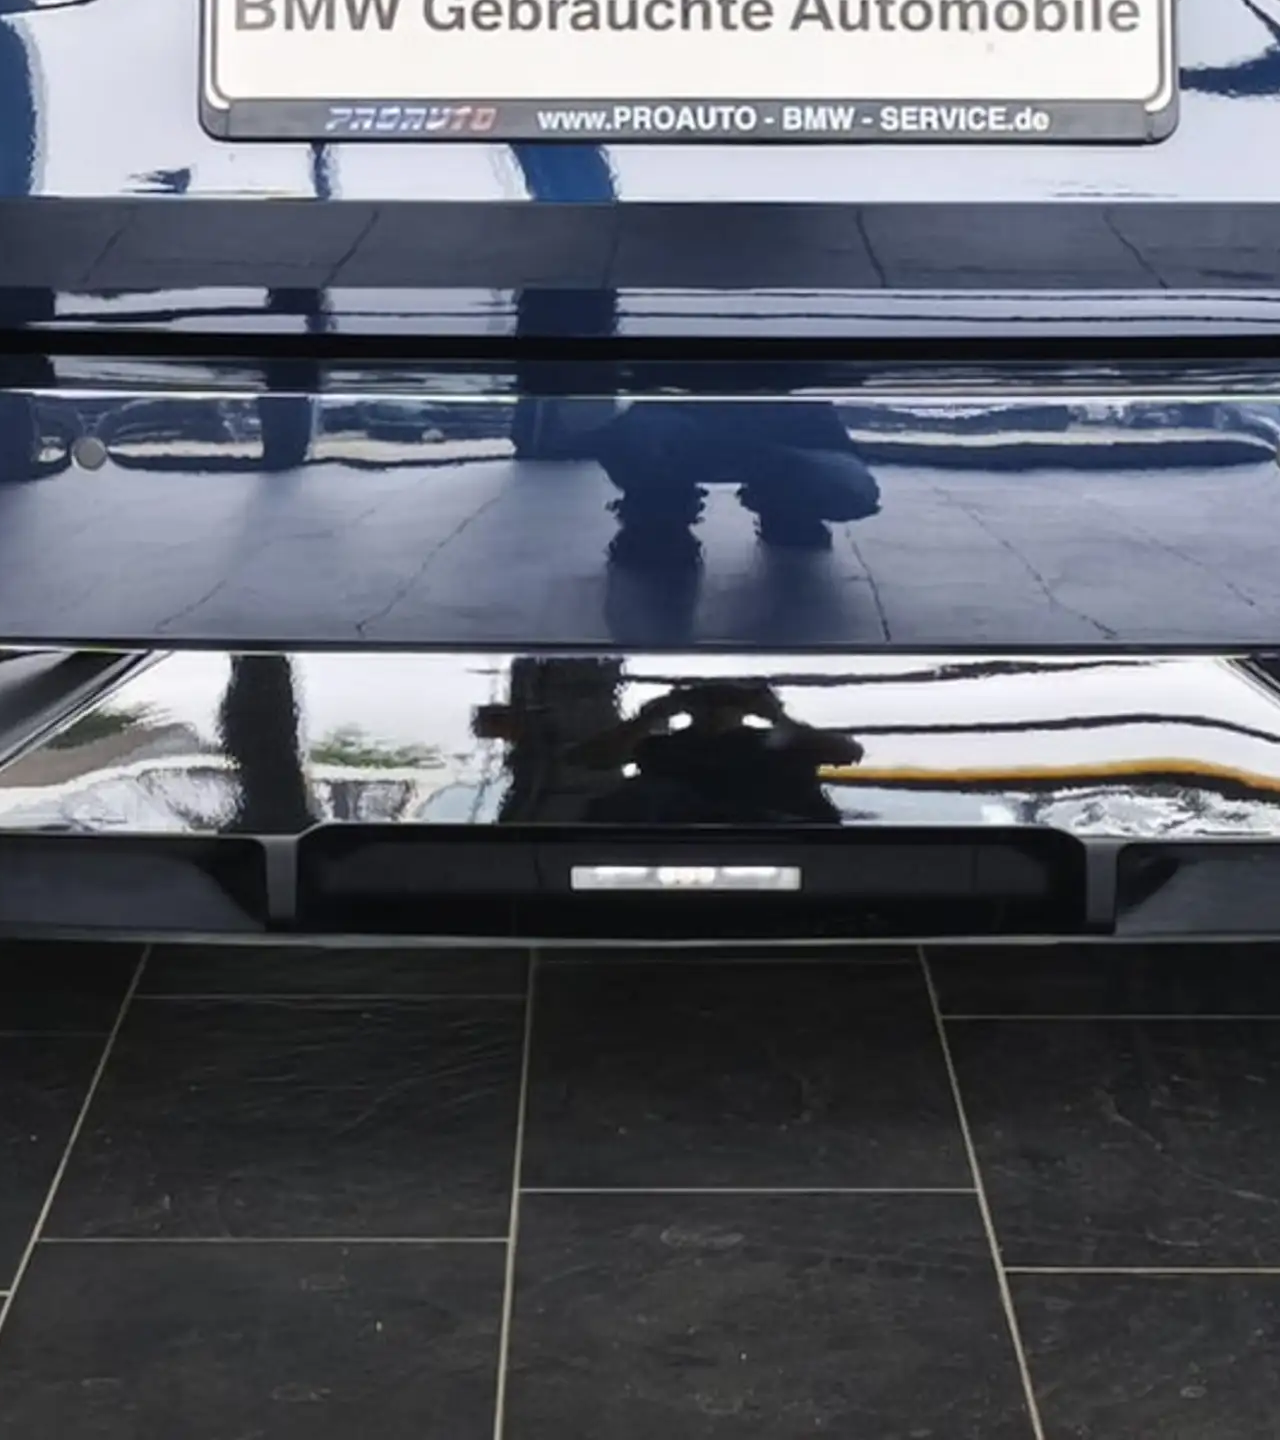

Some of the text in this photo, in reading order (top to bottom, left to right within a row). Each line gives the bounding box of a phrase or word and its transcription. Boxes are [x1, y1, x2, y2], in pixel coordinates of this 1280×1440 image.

[537, 107, 757, 131] www.PROAUTO
[782, 107, 854, 130] BMW
[880, 107, 1050, 131] SERVICE.de
